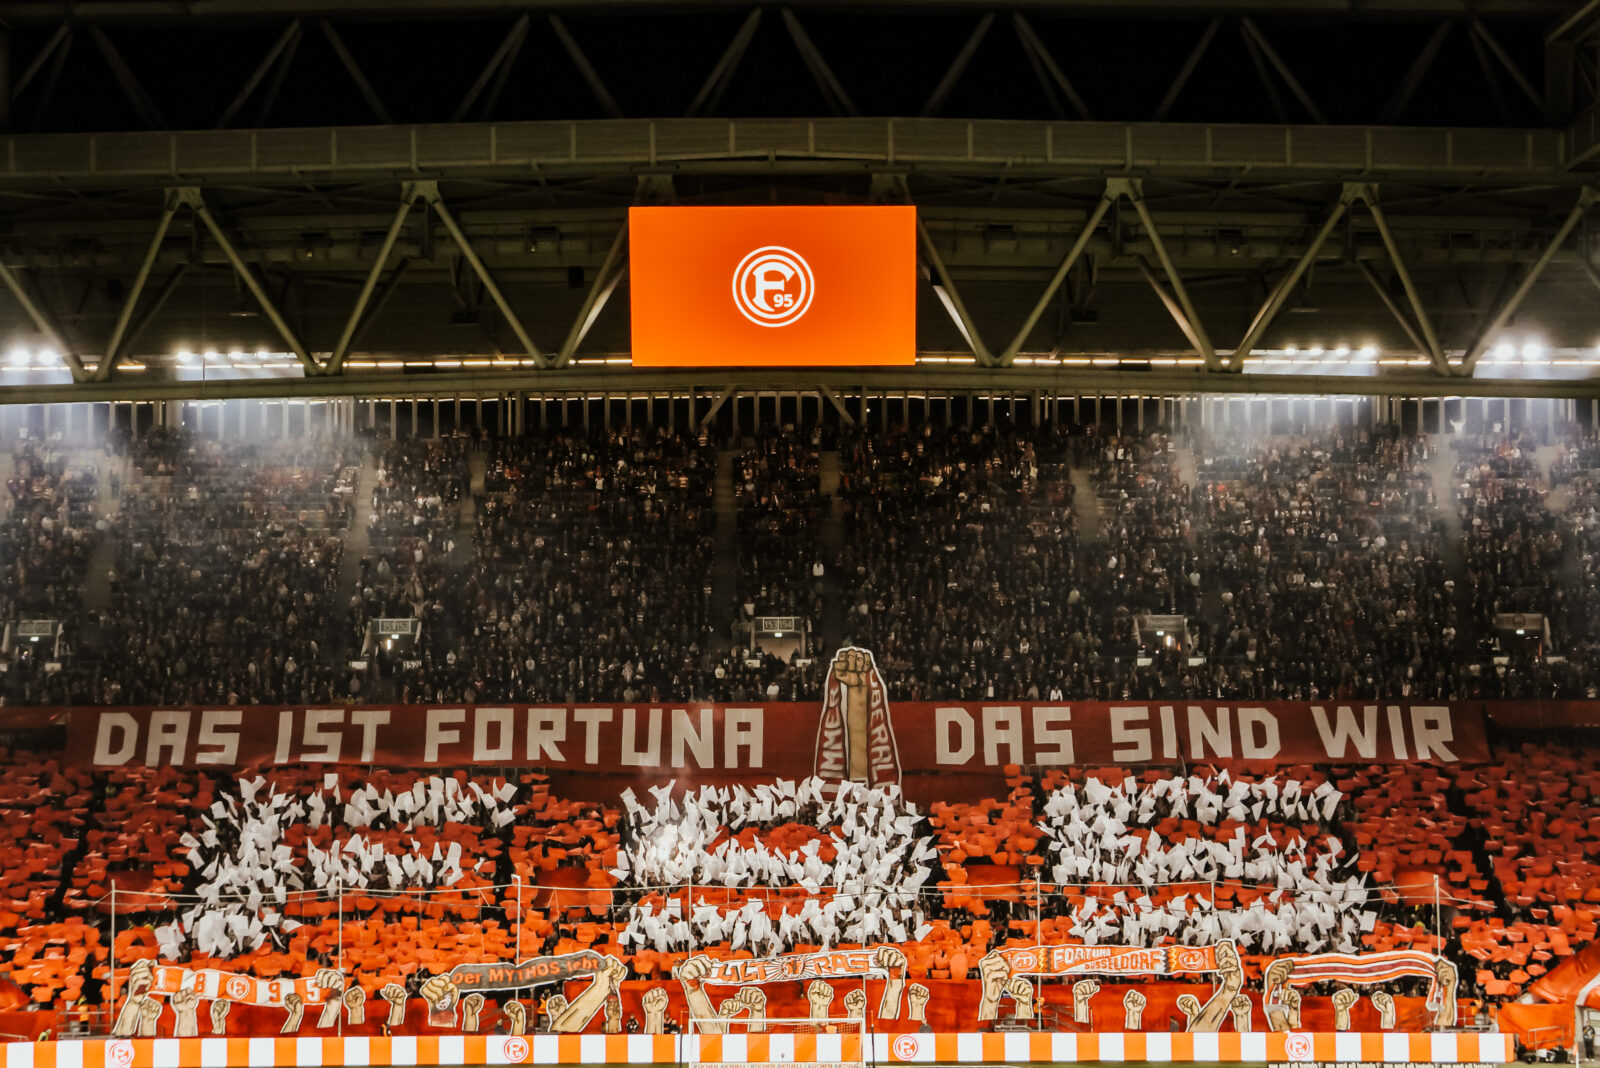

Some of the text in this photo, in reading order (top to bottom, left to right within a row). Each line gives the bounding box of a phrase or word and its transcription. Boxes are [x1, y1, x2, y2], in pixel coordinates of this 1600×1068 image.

[764, 620, 792, 629] 153 154
[93, 705, 1460, 768] DAS IST FORTUNA DAS SIND WIR
[819, 685, 844, 778] IMMER
[453, 956, 598, 984] Der MYTHOS lebt
[1054, 946, 1112, 970] FORTUNA
